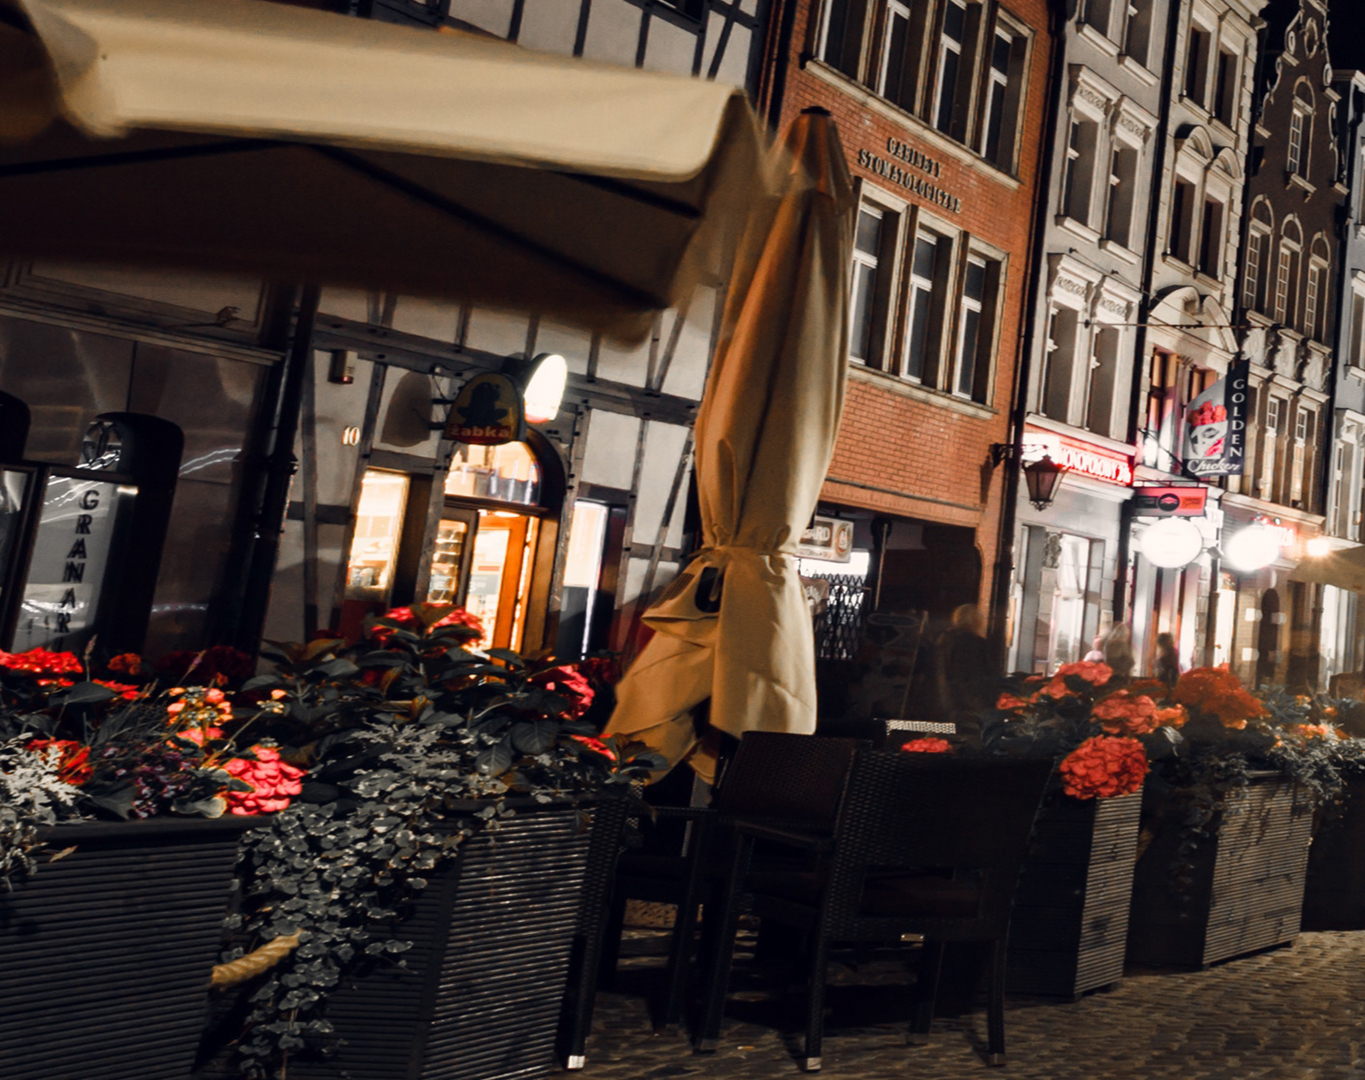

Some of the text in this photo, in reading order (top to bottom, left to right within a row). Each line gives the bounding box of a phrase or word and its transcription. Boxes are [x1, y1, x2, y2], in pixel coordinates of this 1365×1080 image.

[887, 137, 942, 180] GABINETY
[858, 148, 962, 214] STOMATOLOGICZNE
[449, 426, 510, 438] żabka
[1230, 379, 1245, 457] GOLDEN
[342, 426, 361, 446] 10
[1187, 458, 1241, 473] Chicken
